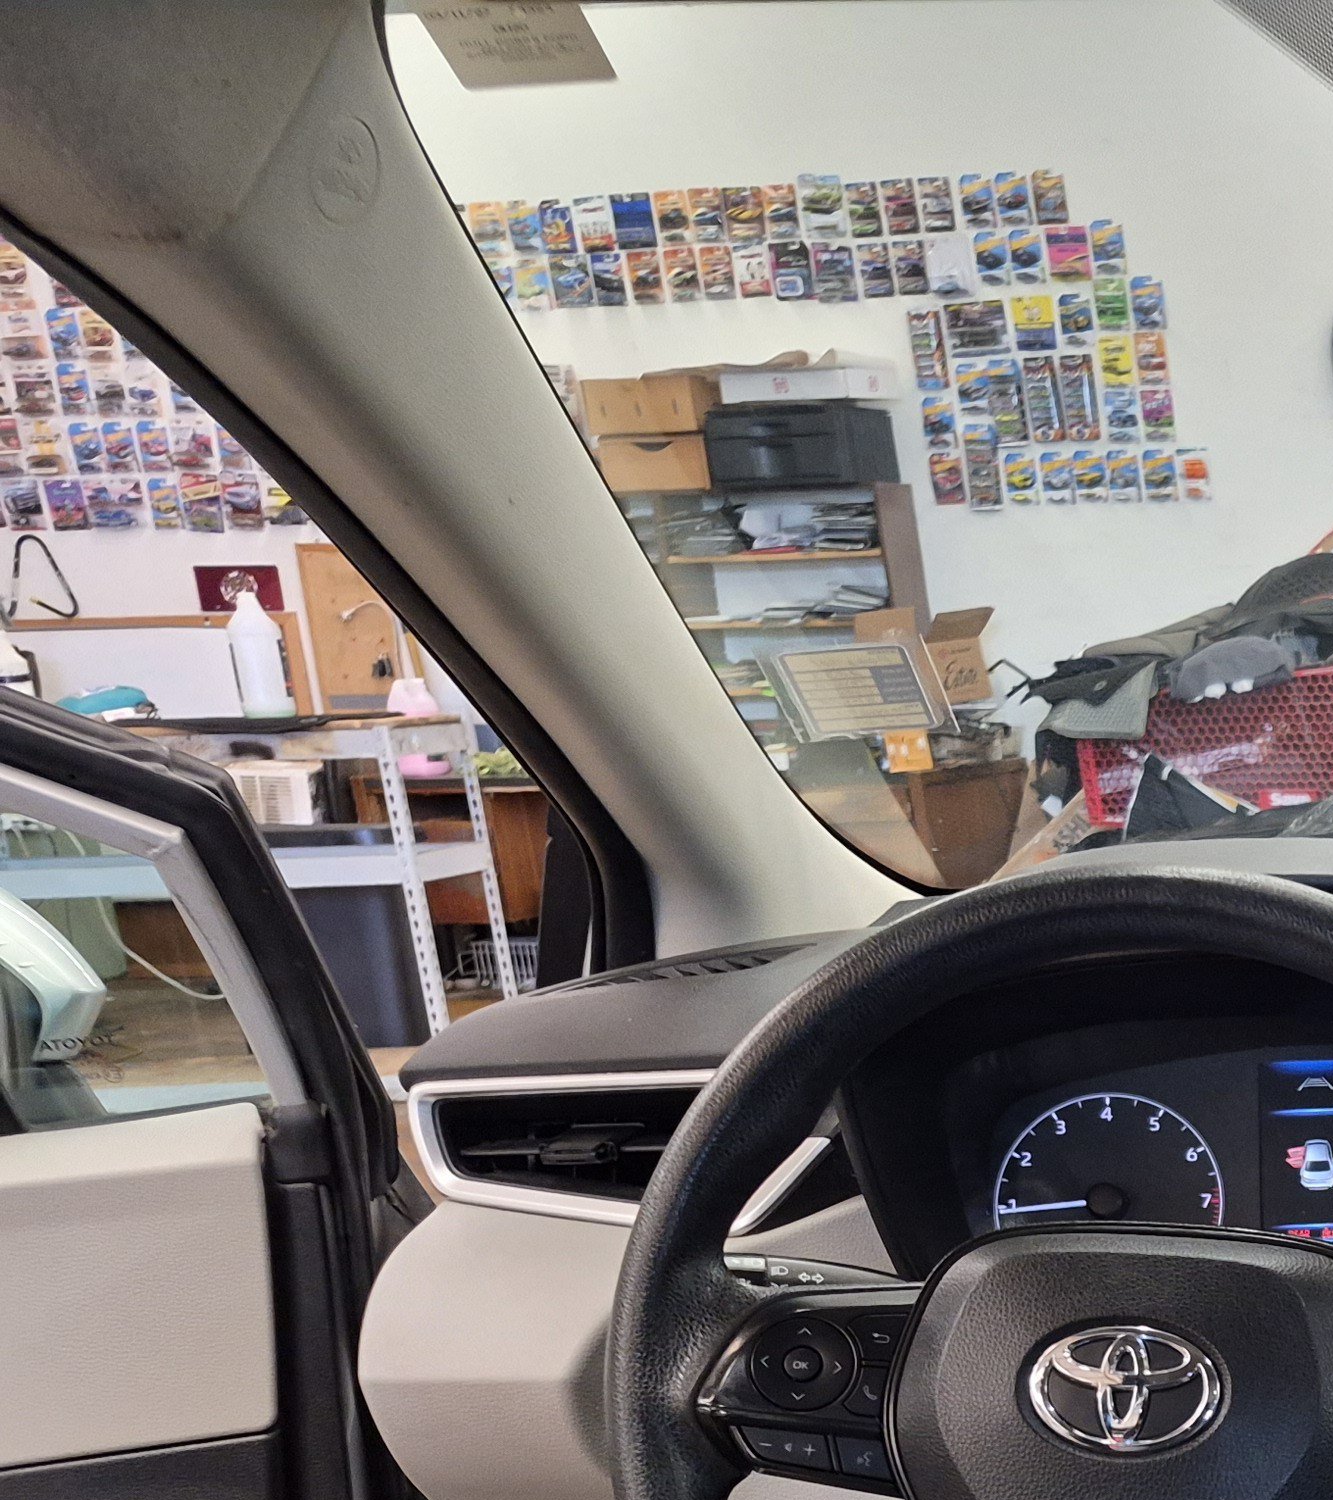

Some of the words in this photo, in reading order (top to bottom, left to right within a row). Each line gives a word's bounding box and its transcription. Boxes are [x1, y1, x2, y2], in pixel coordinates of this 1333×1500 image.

[1100, 1106, 1113, 1122] 4
[1055, 1120, 1067, 1135] 3
[1149, 1117, 1160, 1132] 5
[1020, 1152, 1032, 1167] 2
[1185, 1147, 1198, 1162] 6
[1200, 1193, 1212, 1209] 7
[792, 1360, 809, 1370] OK
